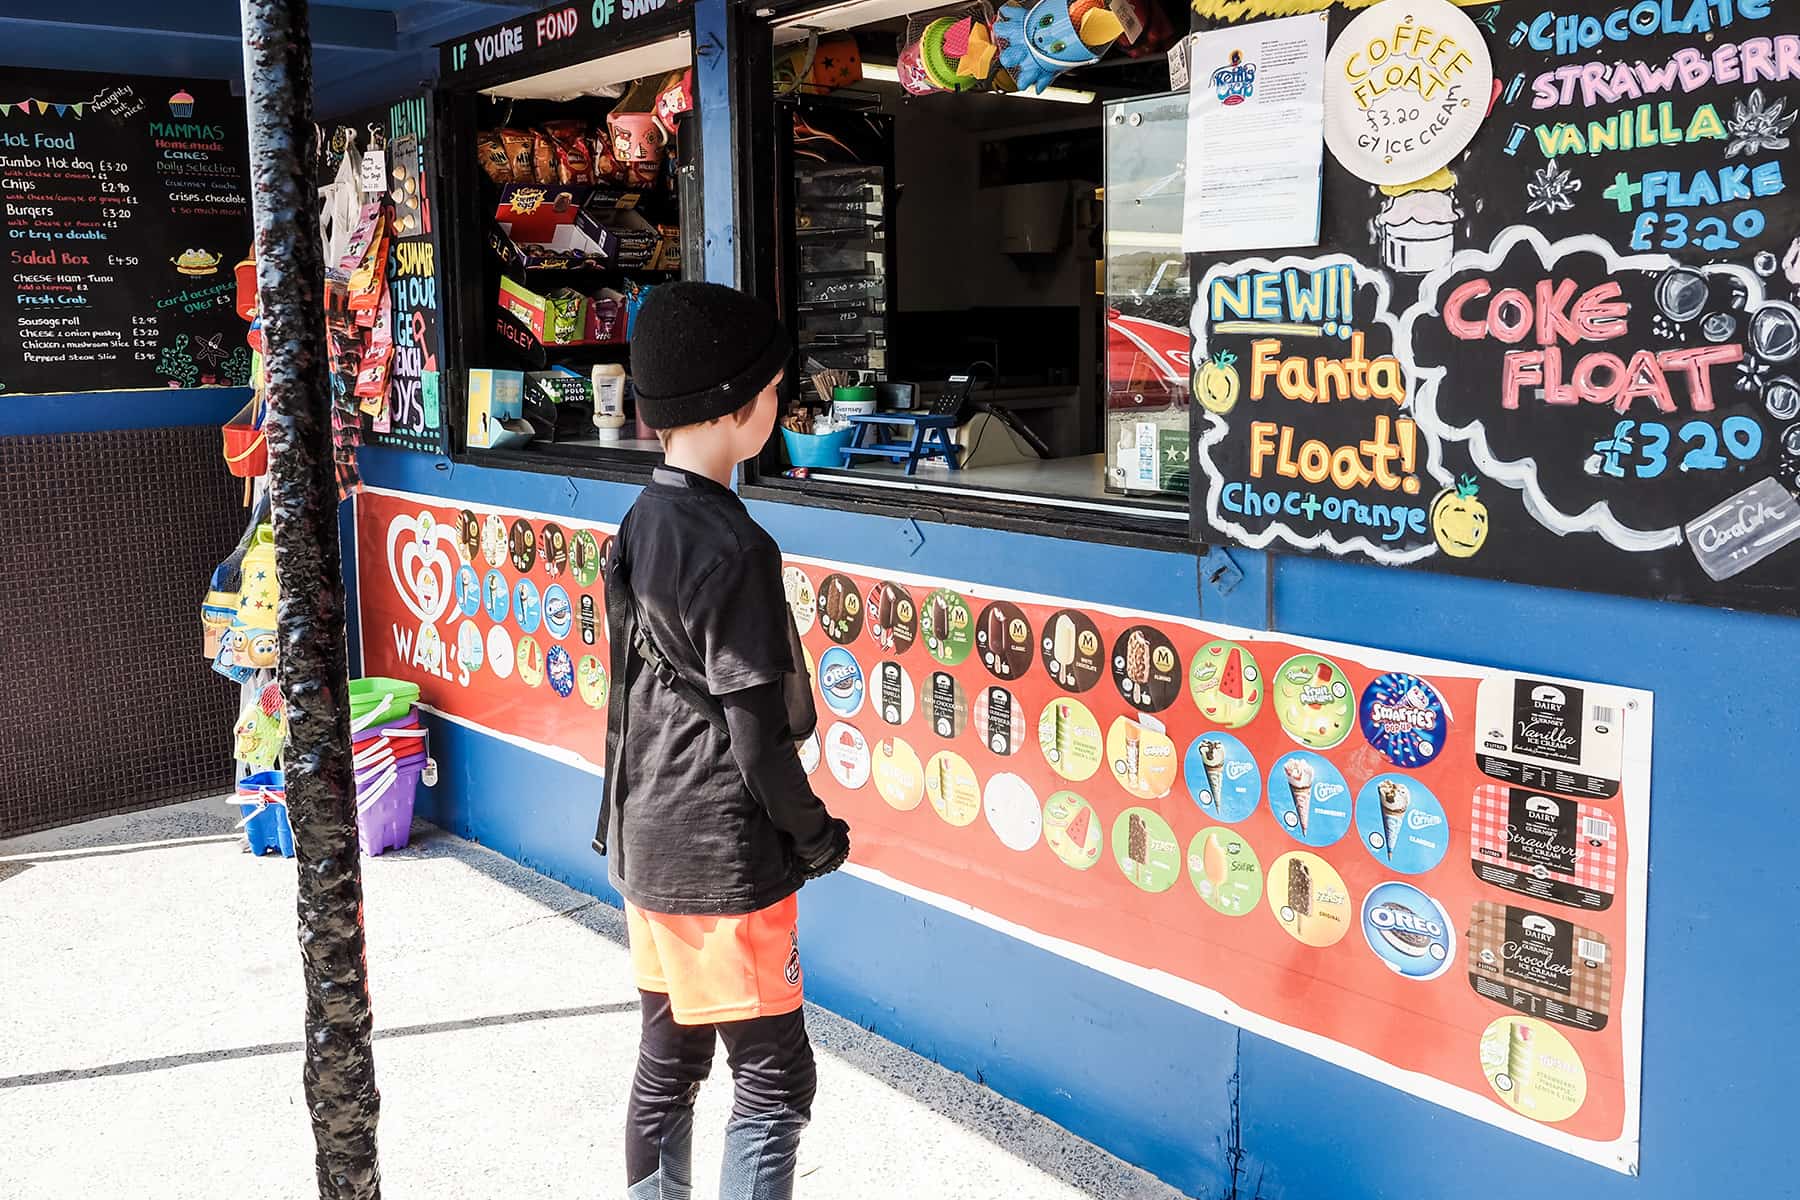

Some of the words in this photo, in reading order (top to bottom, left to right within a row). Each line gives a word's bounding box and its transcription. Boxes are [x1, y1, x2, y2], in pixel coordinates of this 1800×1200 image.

[453, 43, 468, 71] IF
[475, 26, 523, 65] YOU'RE
[536, 8, 578, 47] FOND
[592, 0, 616, 29] OF
[1529, 0, 1771, 55] CHOCOLATE
[1346, 26, 1472, 80] COFFEE
[1532, 35, 1800, 109] STRAWBERR
[1354, 66, 1445, 109] FLOAT
[91, 85, 133, 113] Naughty
[111, 102, 129, 116] but
[123, 99, 148, 118] nice!
[1358, 134, 1380, 153] GY
[1386, 138, 1415, 154] ICE
[1419, 84, 1462, 145] CREAM
[1366, 108, 1420, 132] £3.20
[150, 121, 225, 141] MAMMAS
[1535, 101, 1729, 158] VANILLA
[35, 132, 75, 150] Food
[0, 154, 41, 168] Jumbo
[46, 157, 69, 169] Hot
[71, 157, 94, 173] dog
[156, 161, 184, 174] Daily
[1, 179, 36, 193] Chips
[6, 203, 54, 219] Burgers
[9, 229, 25, 238] Or
[29, 229, 51, 241] try
[54, 231, 63, 239] a
[66, 229, 107, 240] double
[11, 249, 57, 265] Salad
[62, 252, 90, 265] Box
[397, 243, 434, 277] SUMMER
[16, 294, 54, 304] Fresh
[57, 294, 88, 304] Crab
[190, 280, 237, 300] accepte
[409, 277, 436, 310] OUR
[1211, 264, 1353, 340] NEW!!
[1443, 278, 1631, 346] COKE
[17, 316, 61, 328] Sausage
[62, 316, 80, 325] roll
[22, 340, 60, 349] Chicken
[64, 329, 91, 337] onion
[92, 330, 122, 340] pastry
[24, 352, 65, 363] Peppered
[394, 348, 421, 377] EACH
[1250, 331, 1407, 407] Fanta
[1502, 344, 1744, 413] FLOAT
[823, 664, 857, 687] OREO
[1534, 701, 1562, 712] DAIRY
[1518, 721, 1576, 745] Vanilla
[1527, 737, 1541, 745] ICE
[1541, 739, 1567, 750] CREAM
[1528, 811, 1557, 823] DAIRY
[1498, 824, 1584, 863] Strawberry
[1522, 846, 1534, 854] ICE
[1535, 847, 1561, 860] CREAM
[1370, 905, 1441, 936] OREO
[1525, 930, 1552, 942] DAIRY
[1500, 941, 1575, 976] Chocolate
[1518, 962, 1531, 970] ICE
[1531, 966, 1557, 979] CREAM
